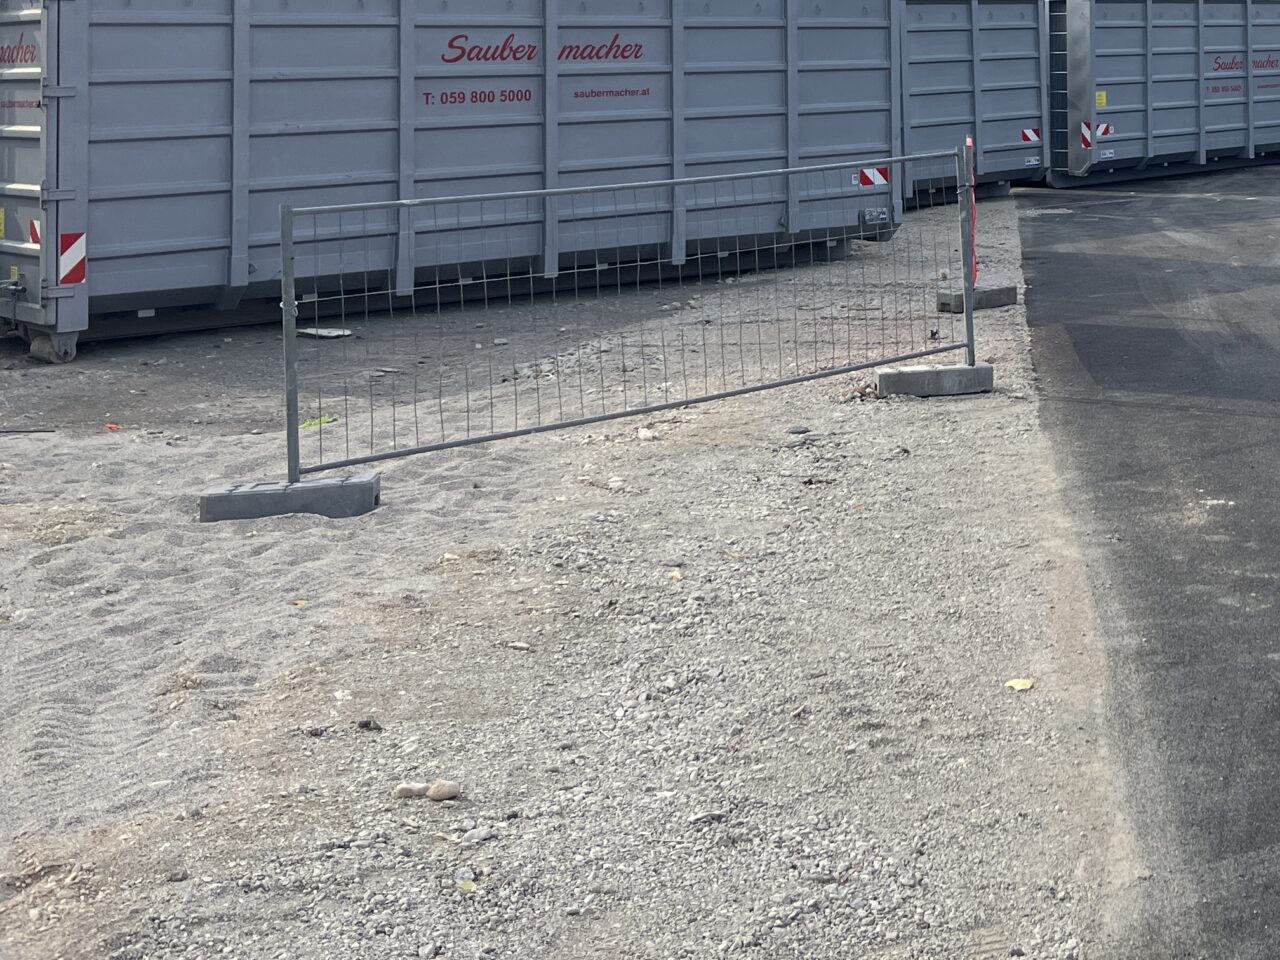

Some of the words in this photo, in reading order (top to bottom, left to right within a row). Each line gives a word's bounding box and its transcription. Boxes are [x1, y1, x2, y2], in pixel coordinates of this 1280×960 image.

[441, 33, 538, 63] Sauber
[557, 33, 643, 61] macher
[1212, 55, 1243, 71] Sauber
[422, 92, 435, 105] T:
[440, 92, 466, 105] 059
[470, 91, 496, 104] 800
[500, 89, 532, 103] 5000
[573, 88, 650, 99] saubermacher.at
